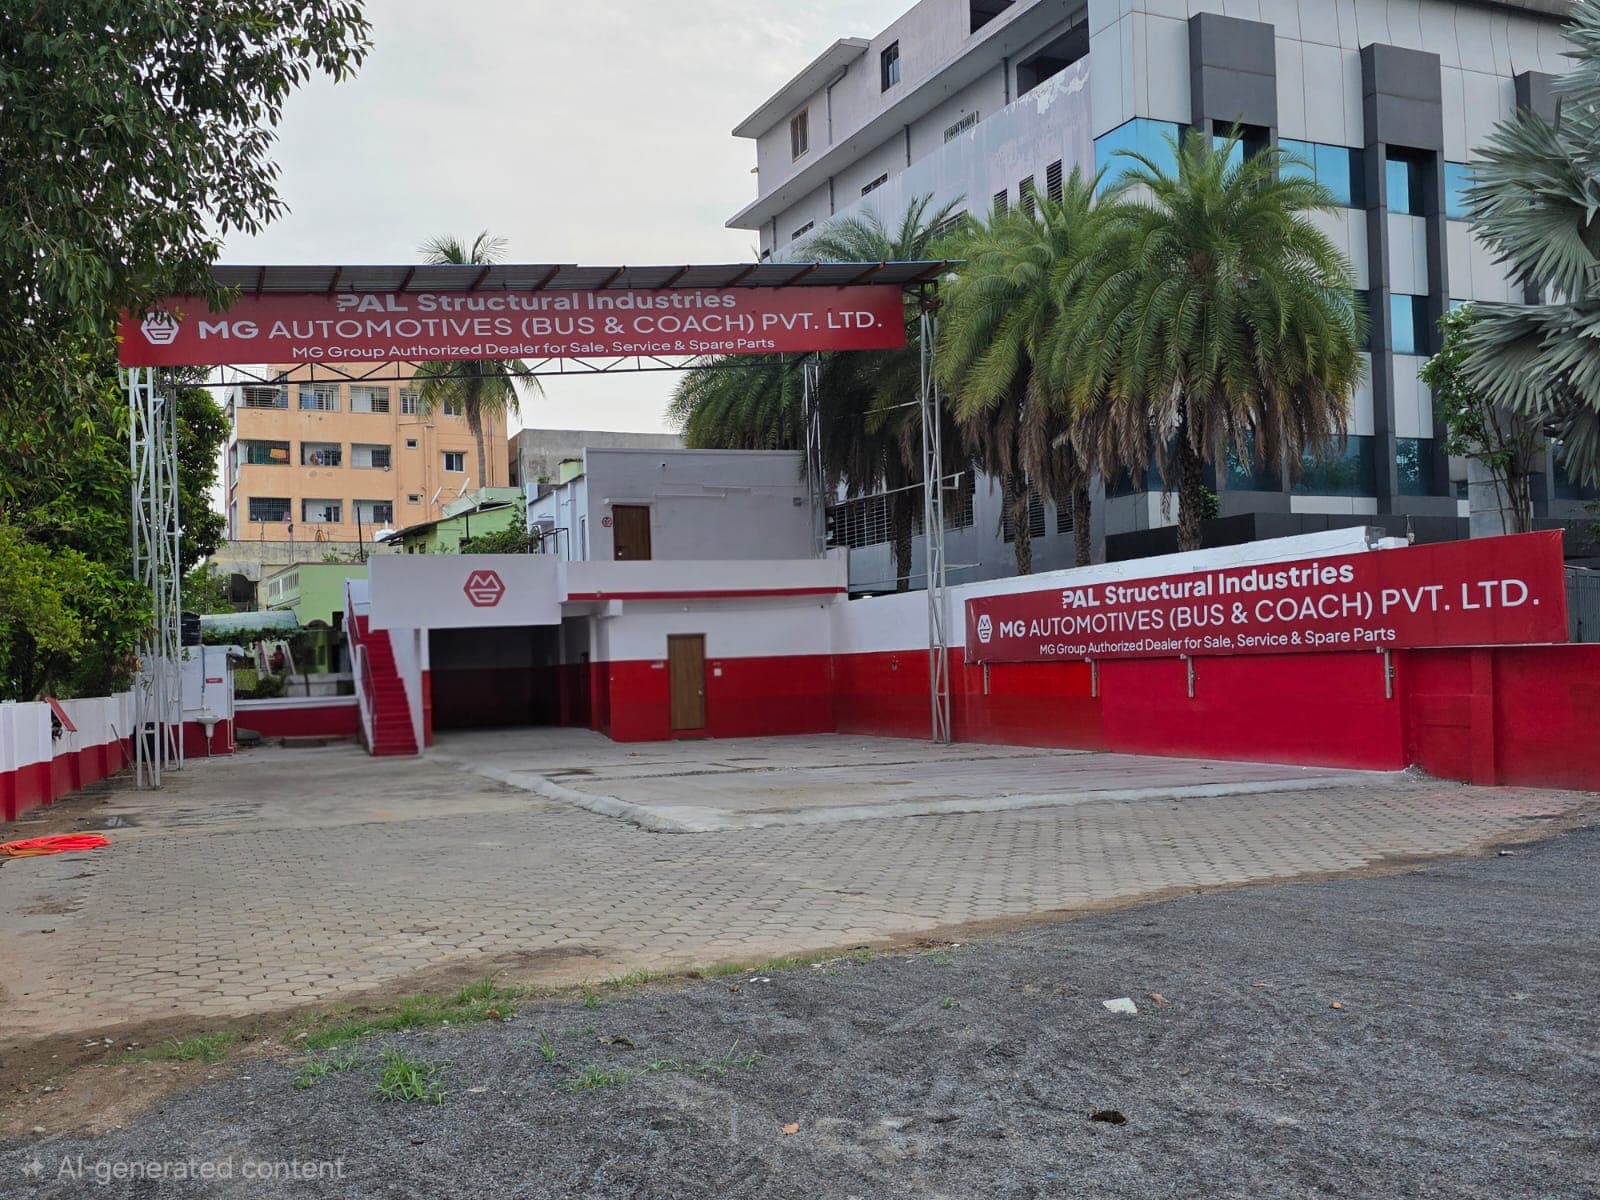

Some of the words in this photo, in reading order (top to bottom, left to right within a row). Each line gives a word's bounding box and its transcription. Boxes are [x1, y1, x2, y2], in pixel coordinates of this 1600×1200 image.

[335, 294, 409, 313] PAL
[417, 292, 579, 312] Structural
[587, 291, 736, 310] Industries
[199, 320, 259, 340] MG
[268, 318, 512, 340] AUTOMOTIVES
[521, 316, 595, 338] (BUS
[604, 316, 625, 335] &
[633, 313, 754, 335] COACH)
[762, 312, 819, 331] PVT.
[827, 311, 882, 329] LTD.
[292, 346, 324, 358] MG
[328, 346, 385, 359] Group
[388, 343, 482, 357] Authorized
[485, 343, 540, 355] Dealer
[543, 342, 566, 354] for
[612, 340, 671, 353] Service
[674, 340, 686, 351] &
[689, 338, 734, 352] Spare
[737, 338, 775, 350] Parts
[1061, 588, 1101, 609] PAL
[1104, 574, 1212, 604] Structural
[1218, 562, 1354, 594] Industries
[999, 619, 1026, 639] MG
[1029, 609, 1164, 638] AUTOMOTIVES
[1169, 603, 1224, 632] (BUS
[1231, 601, 1249, 624] &
[1254, 590, 1373, 624] COACH)
[1381, 584, 1450, 615] PVT.
[1461, 578, 1540, 610] LTD.
[1039, 644, 1056, 655] MG
[1056, 643, 1087, 656] Group
[1087, 639, 1143, 654] Authorized
[1145, 637, 1182, 651] Dealer
[1184, 637, 1202, 649] for
[1203, 635, 1235, 649] Sale,
[1236, 632, 1289, 647] Service
[1290, 631, 1302, 645] &
[1304, 629, 1351, 647] Spare
[1353, 627, 1396, 642] Parts
